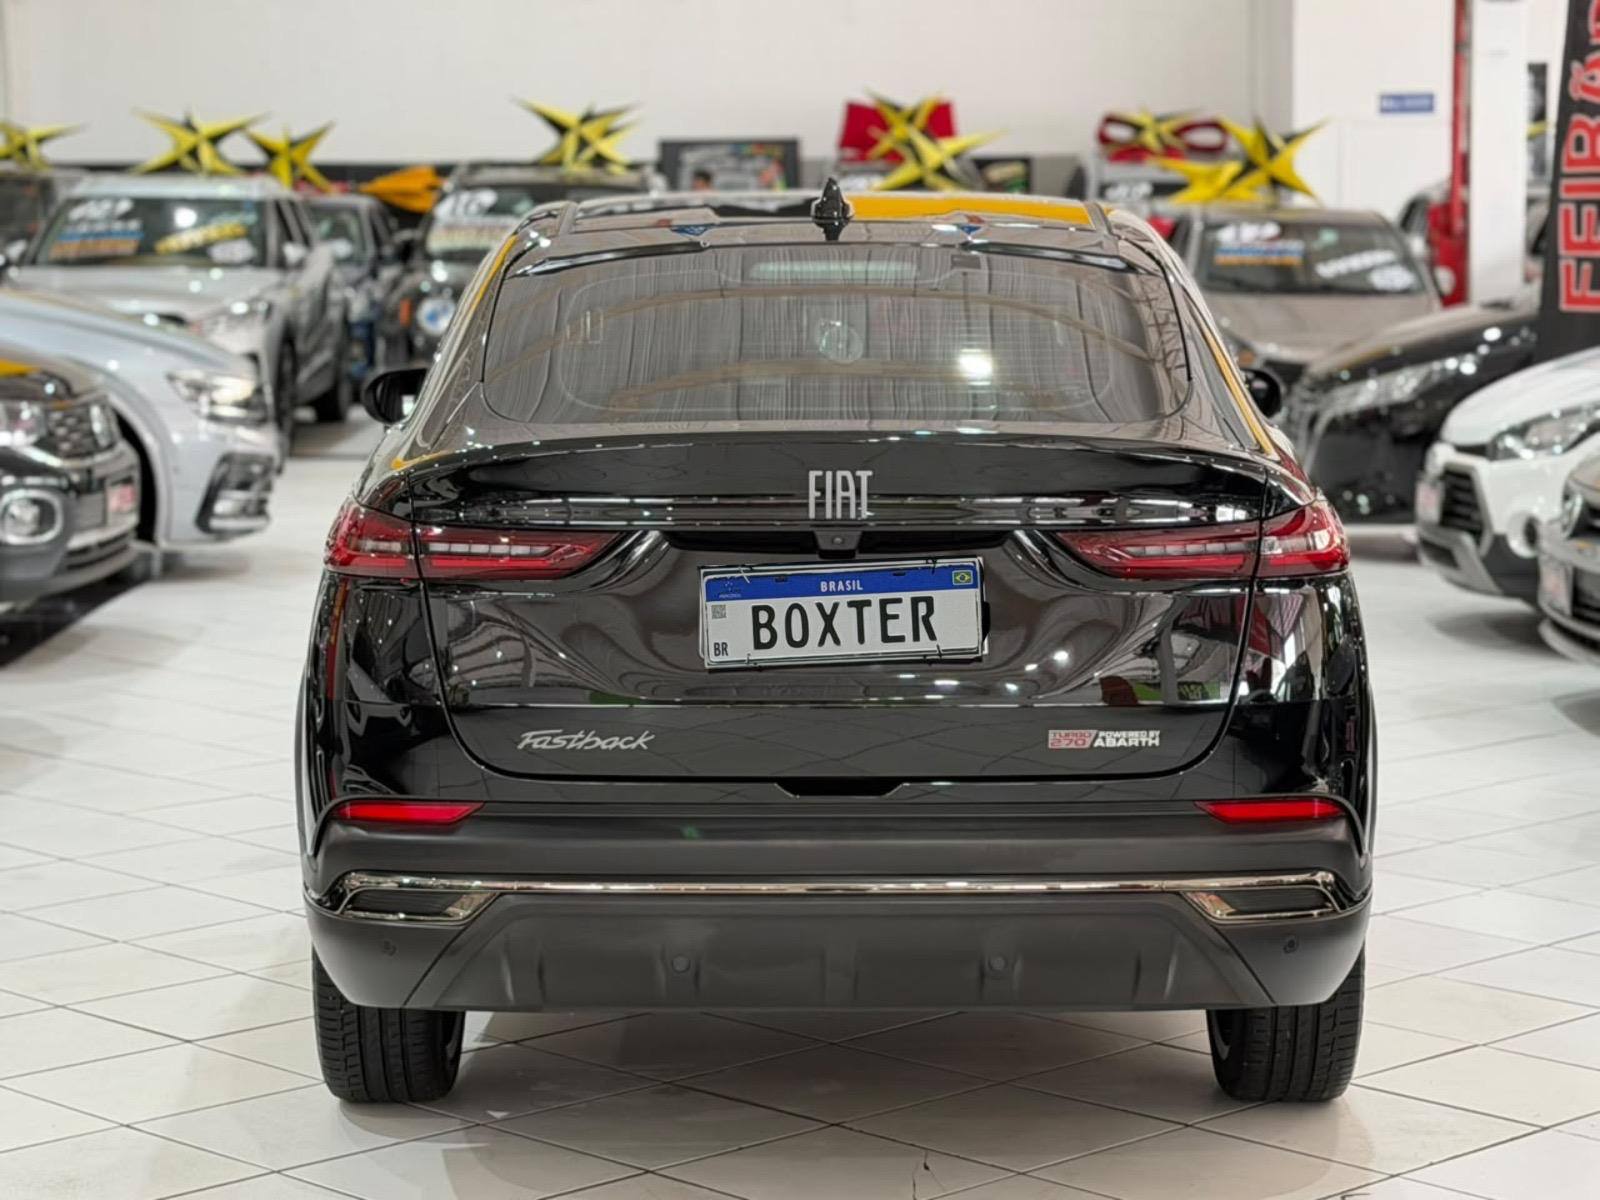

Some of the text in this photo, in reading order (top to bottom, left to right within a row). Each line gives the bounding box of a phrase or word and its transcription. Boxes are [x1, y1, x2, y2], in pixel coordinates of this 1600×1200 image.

[809, 470, 872, 519] FIAT
[820, 580, 863, 592] BRASIL
[751, 596, 938, 650] BOXTER
[713, 642, 729, 657] BR
[517, 729, 655, 750] Fastback
[1099, 730, 1160, 738] POWERED BY
[1050, 739, 1087, 747] 270
[1093, 738, 1160, 747] ABARTH
